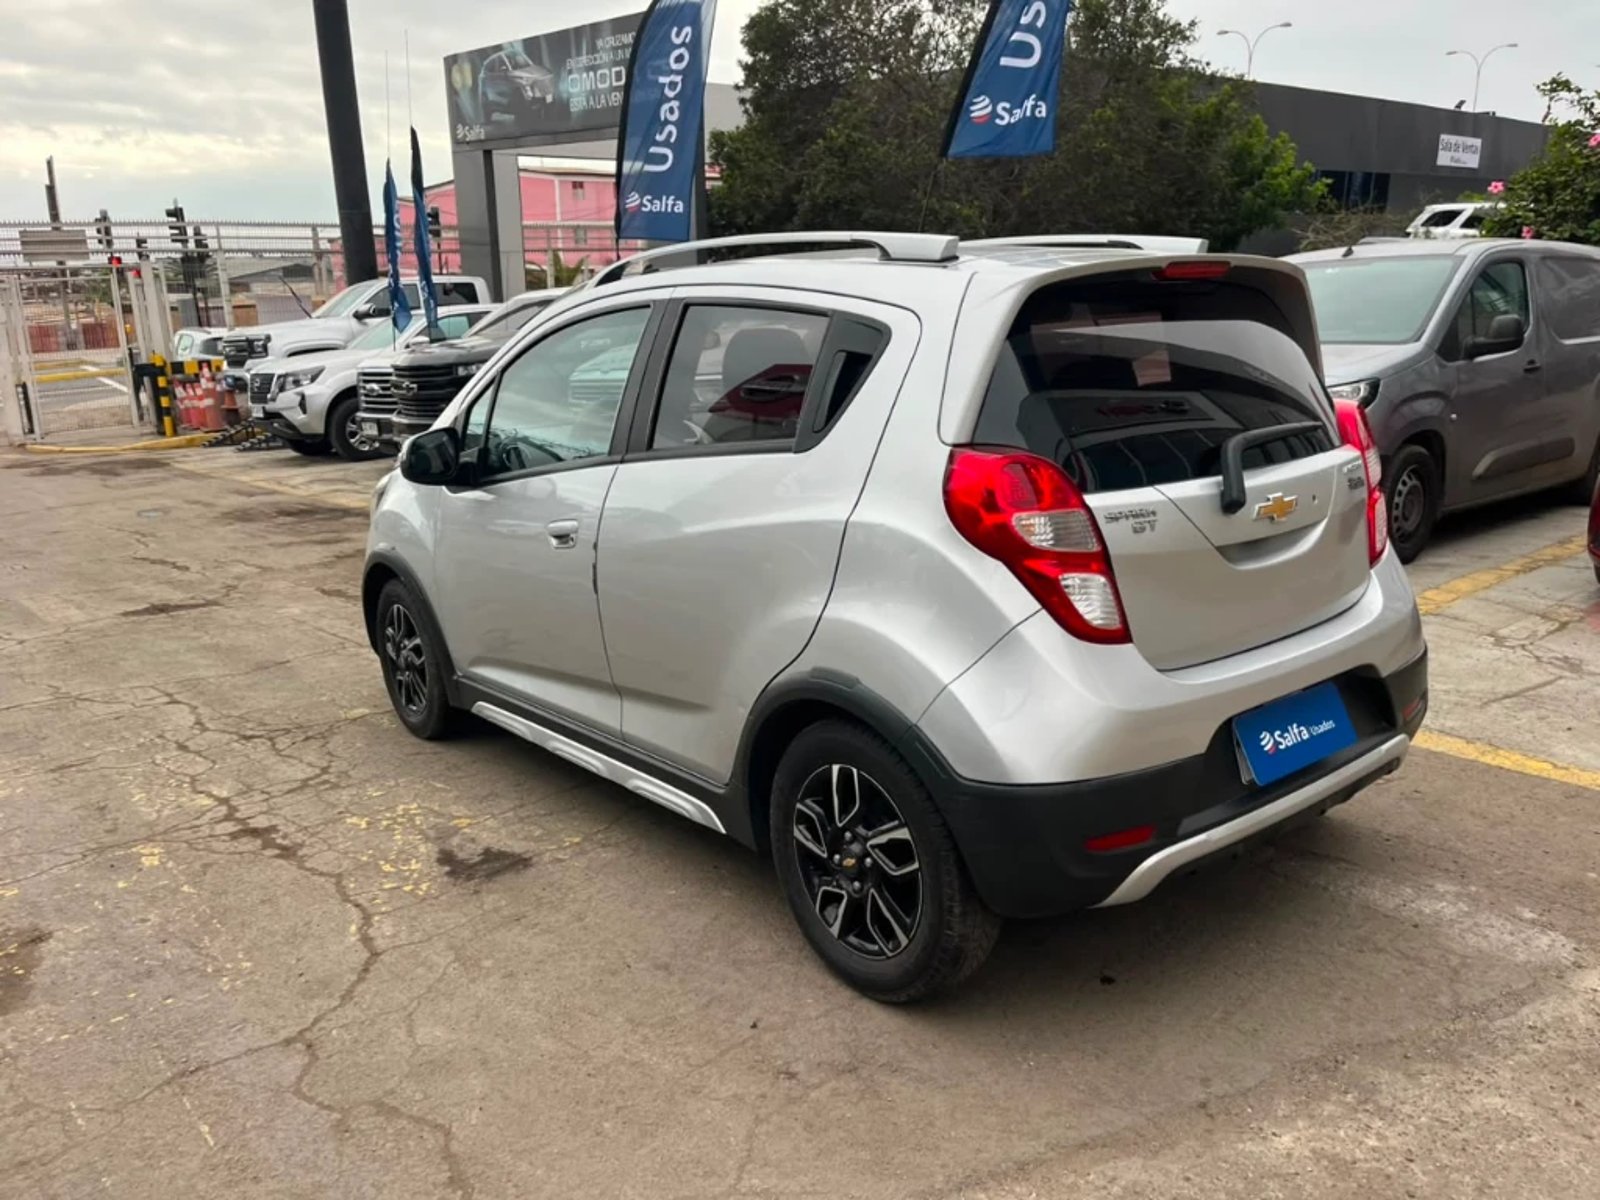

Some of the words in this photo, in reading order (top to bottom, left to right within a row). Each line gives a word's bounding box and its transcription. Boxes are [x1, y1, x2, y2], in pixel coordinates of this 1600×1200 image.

[643, 25, 692, 172] Usados
[995, 94, 1047, 125] Salfa
[641, 195, 684, 213] Salfa
[1274, 723, 1310, 749] Salfa
